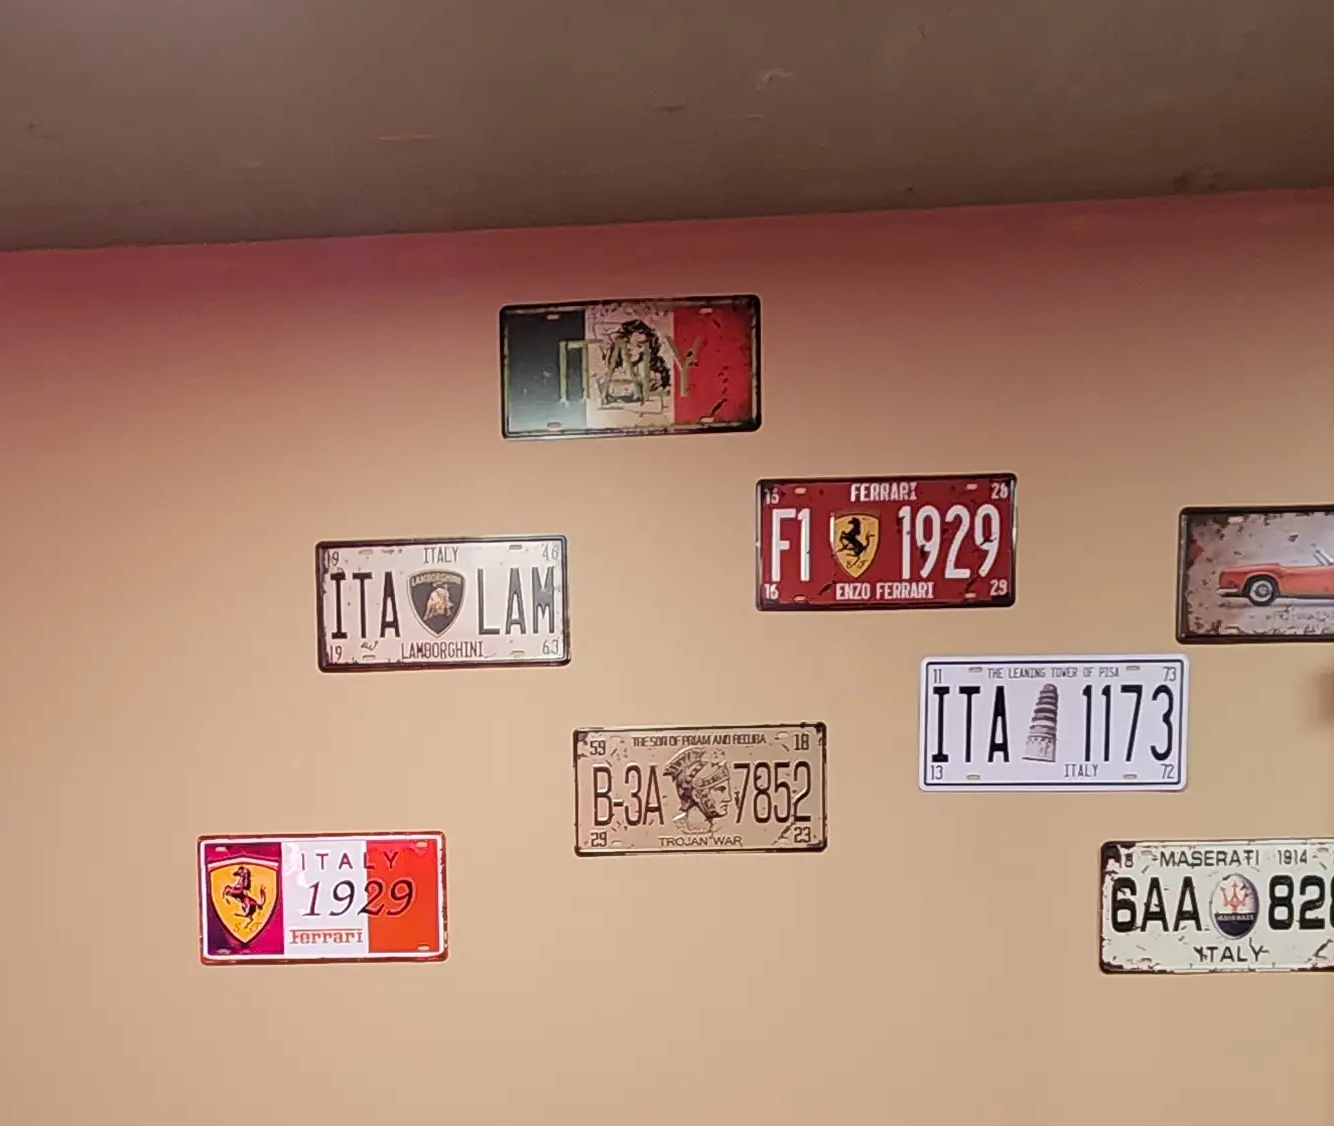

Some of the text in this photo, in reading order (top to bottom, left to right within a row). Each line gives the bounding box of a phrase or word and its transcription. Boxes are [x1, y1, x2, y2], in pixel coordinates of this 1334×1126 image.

[850, 482, 918, 501] FERRARI
[772, 504, 1001, 582] F1 1929
[423, 547, 460, 565] ITALY
[836, 582, 935, 600] ENZO FERRARI
[990, 580, 1008, 596] 29
[330, 565, 556, 640] ITA LAM
[329, 645, 343, 661] 19
[401, 641, 485, 660] LAMBORGHINI
[542, 640, 560, 656] 63
[933, 668, 943, 684] 11
[987, 667, 1004, 679] THE
[1008, 667, 1046, 679] LEANING
[1083, 666, 1095, 678] OF
[1163, 667, 1177, 683] 73
[931, 684, 1174, 763] ITA 1173
[590, 740, 607, 756] 59
[794, 734, 810, 751] 18
[930, 765, 944, 781] 13
[1064, 763, 1100, 778] ITALY
[1161, 764, 1176, 780] 72
[593, 761, 812, 826] B-3A 7852
[590, 831, 608, 848] 29
[658, 835, 744, 848] TROJAN WAR
[793, 827, 812, 843] 23
[301, 851, 400, 871] ITALY
[1160, 850, 1260, 868] MASERATI
[1278, 849, 1308, 866] 1914
[302, 879, 415, 917] 1929
[1111, 876, 1202, 933] 6AA
[289, 928, 364, 945] Ferrari
[1199, 944, 1264, 963] ITALY
